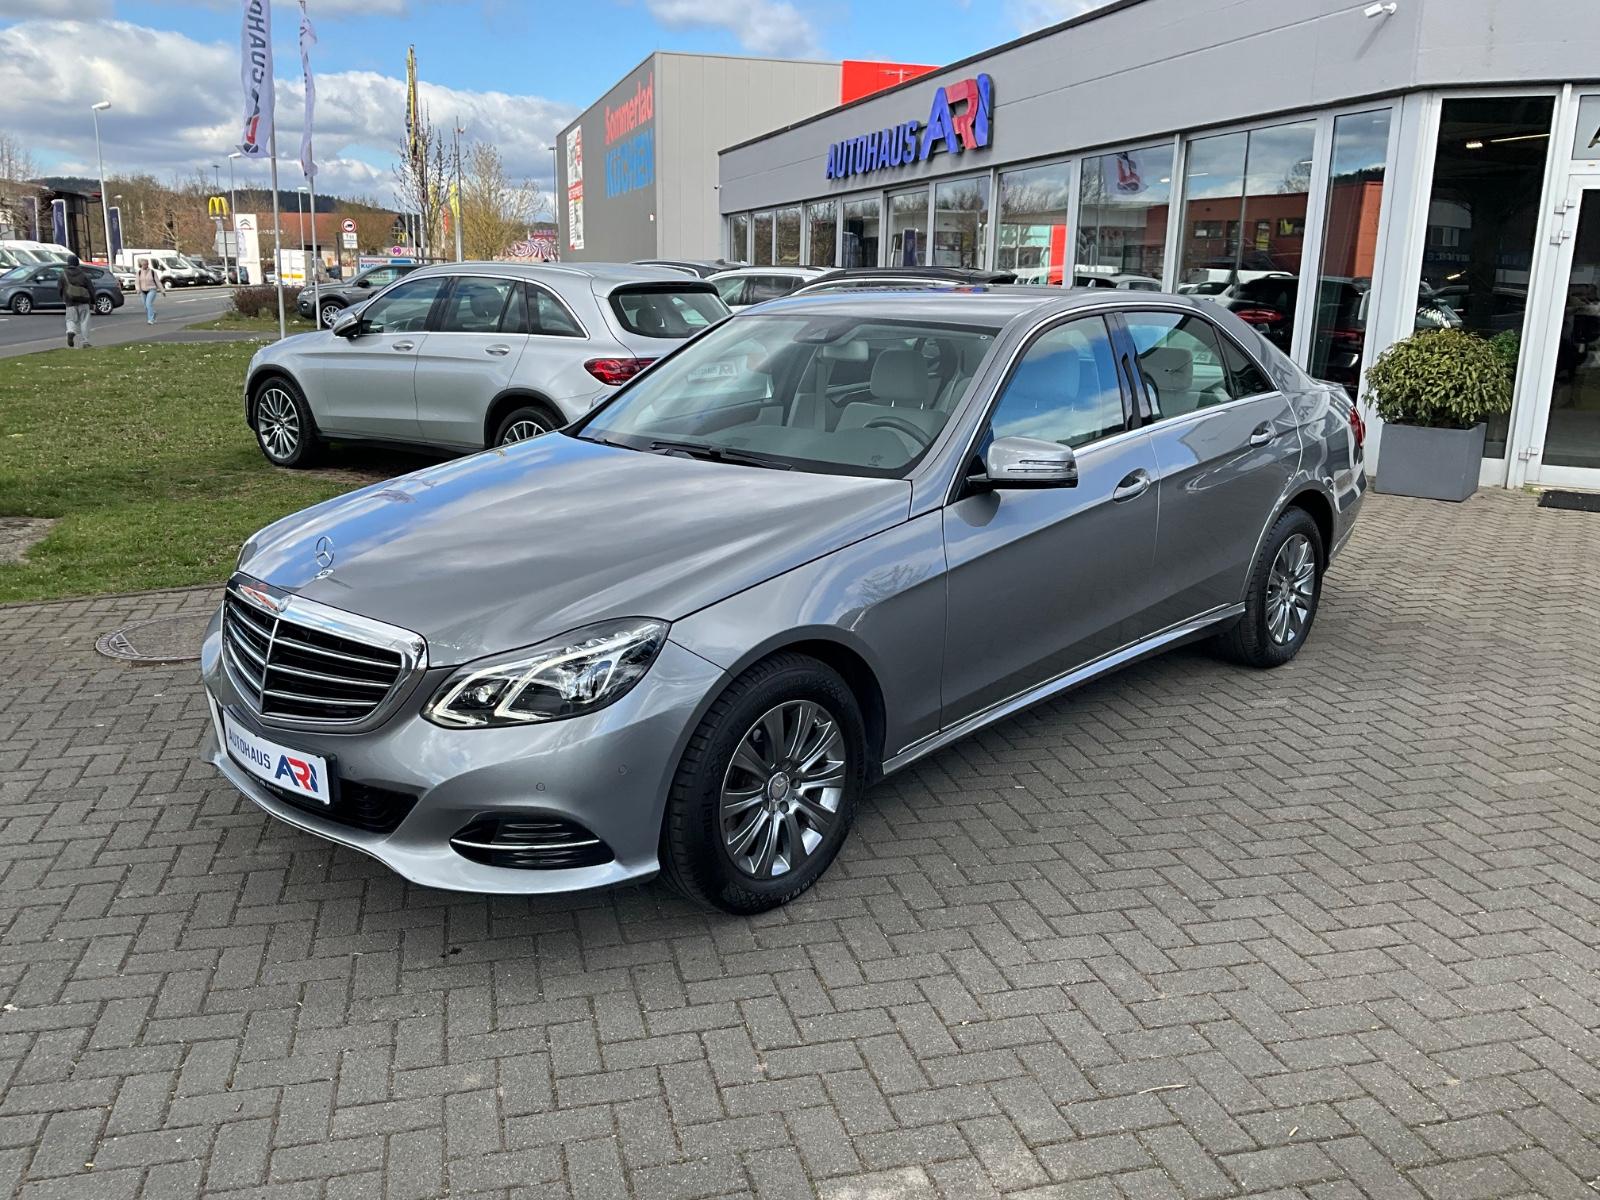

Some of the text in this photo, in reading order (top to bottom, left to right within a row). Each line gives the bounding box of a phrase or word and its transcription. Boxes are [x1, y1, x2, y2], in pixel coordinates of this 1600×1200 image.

[605, 73, 653, 146] Sommerlad
[826, 73, 993, 180] AUTOHAUS ARI
[228, 727, 271, 770] AUTOHAUS
[274, 754, 319, 793] ARI
